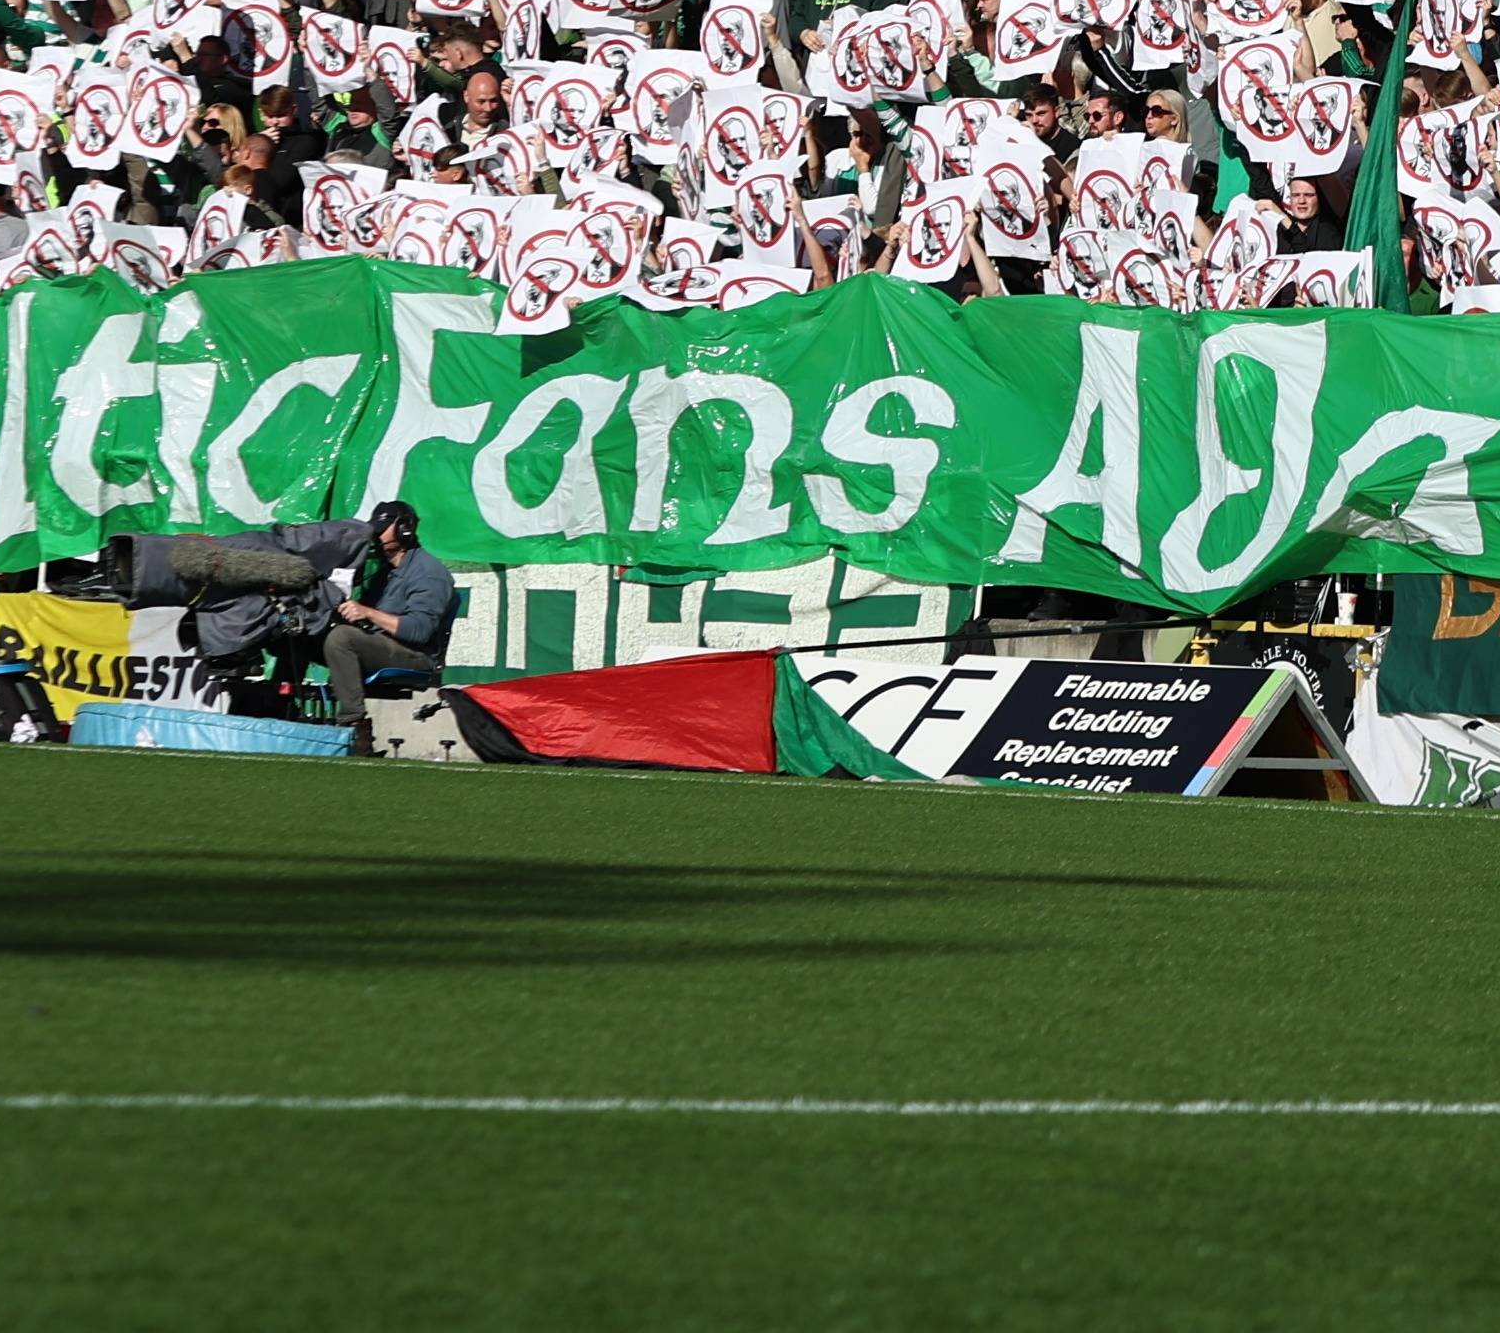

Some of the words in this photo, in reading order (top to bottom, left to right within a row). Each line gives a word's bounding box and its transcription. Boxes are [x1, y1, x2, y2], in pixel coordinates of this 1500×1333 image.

[352, 292, 957, 547] Fans
[1053, 674, 1212, 703] Flammable
[1047, 707, 1173, 739] Cladding
[992, 739, 1180, 767] Replacement
